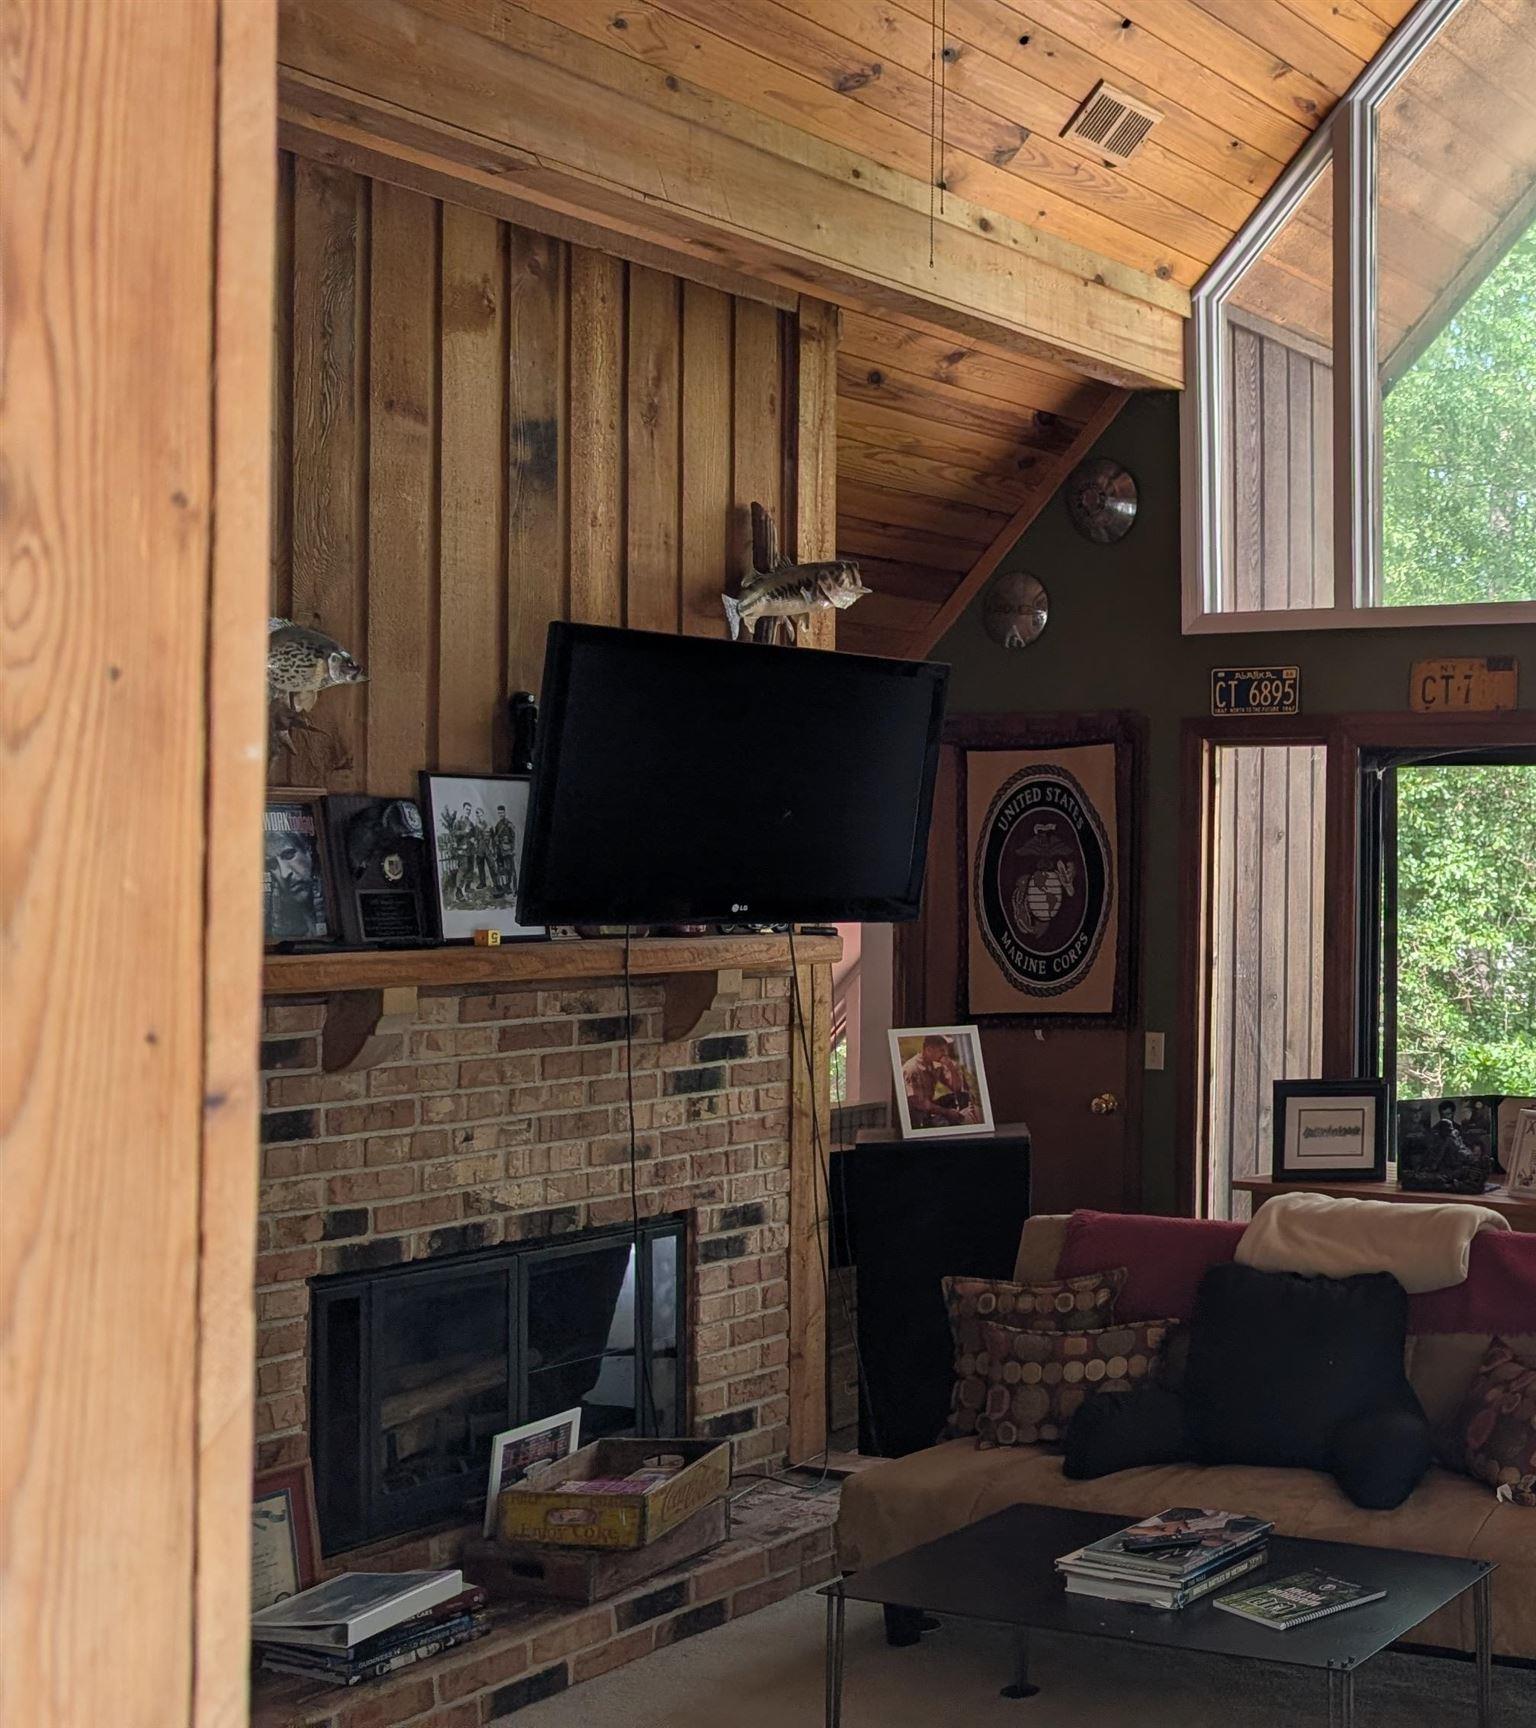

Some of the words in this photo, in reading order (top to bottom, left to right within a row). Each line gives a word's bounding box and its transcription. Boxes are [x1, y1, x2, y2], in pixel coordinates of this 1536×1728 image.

[1215, 680, 1238, 708] CT
[1248, 679, 1295, 706] 6895
[997, 786, 1042, 832] UNITED
[1044, 786, 1085, 831] STATES
[1000, 930, 1047, 976] MARINE
[1052, 931, 1090, 974] CORPS
